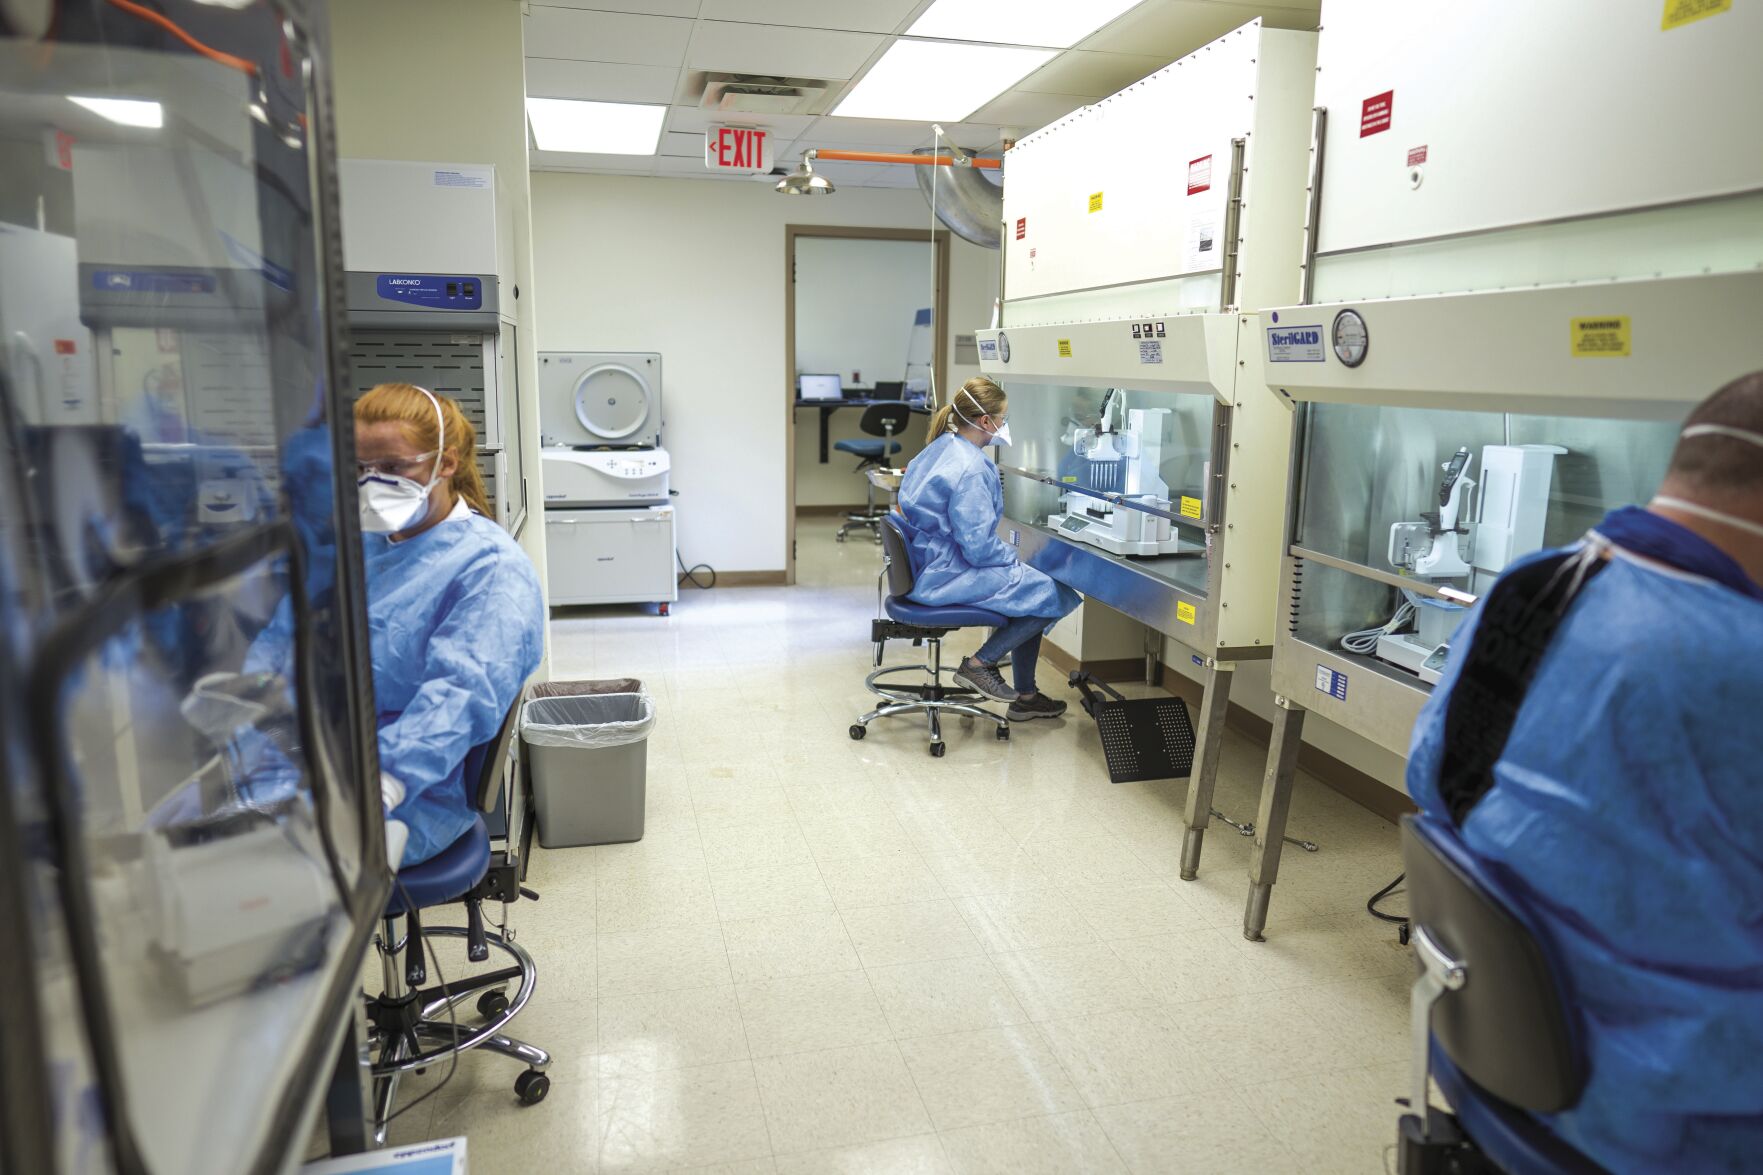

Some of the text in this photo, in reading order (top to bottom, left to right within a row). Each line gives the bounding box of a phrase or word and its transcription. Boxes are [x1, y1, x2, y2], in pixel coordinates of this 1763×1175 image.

[718, 128, 766, 169] EXIT
[1579, 319, 1621, 331] WARNING
[1271, 331, 1319, 346] SterilGARD
